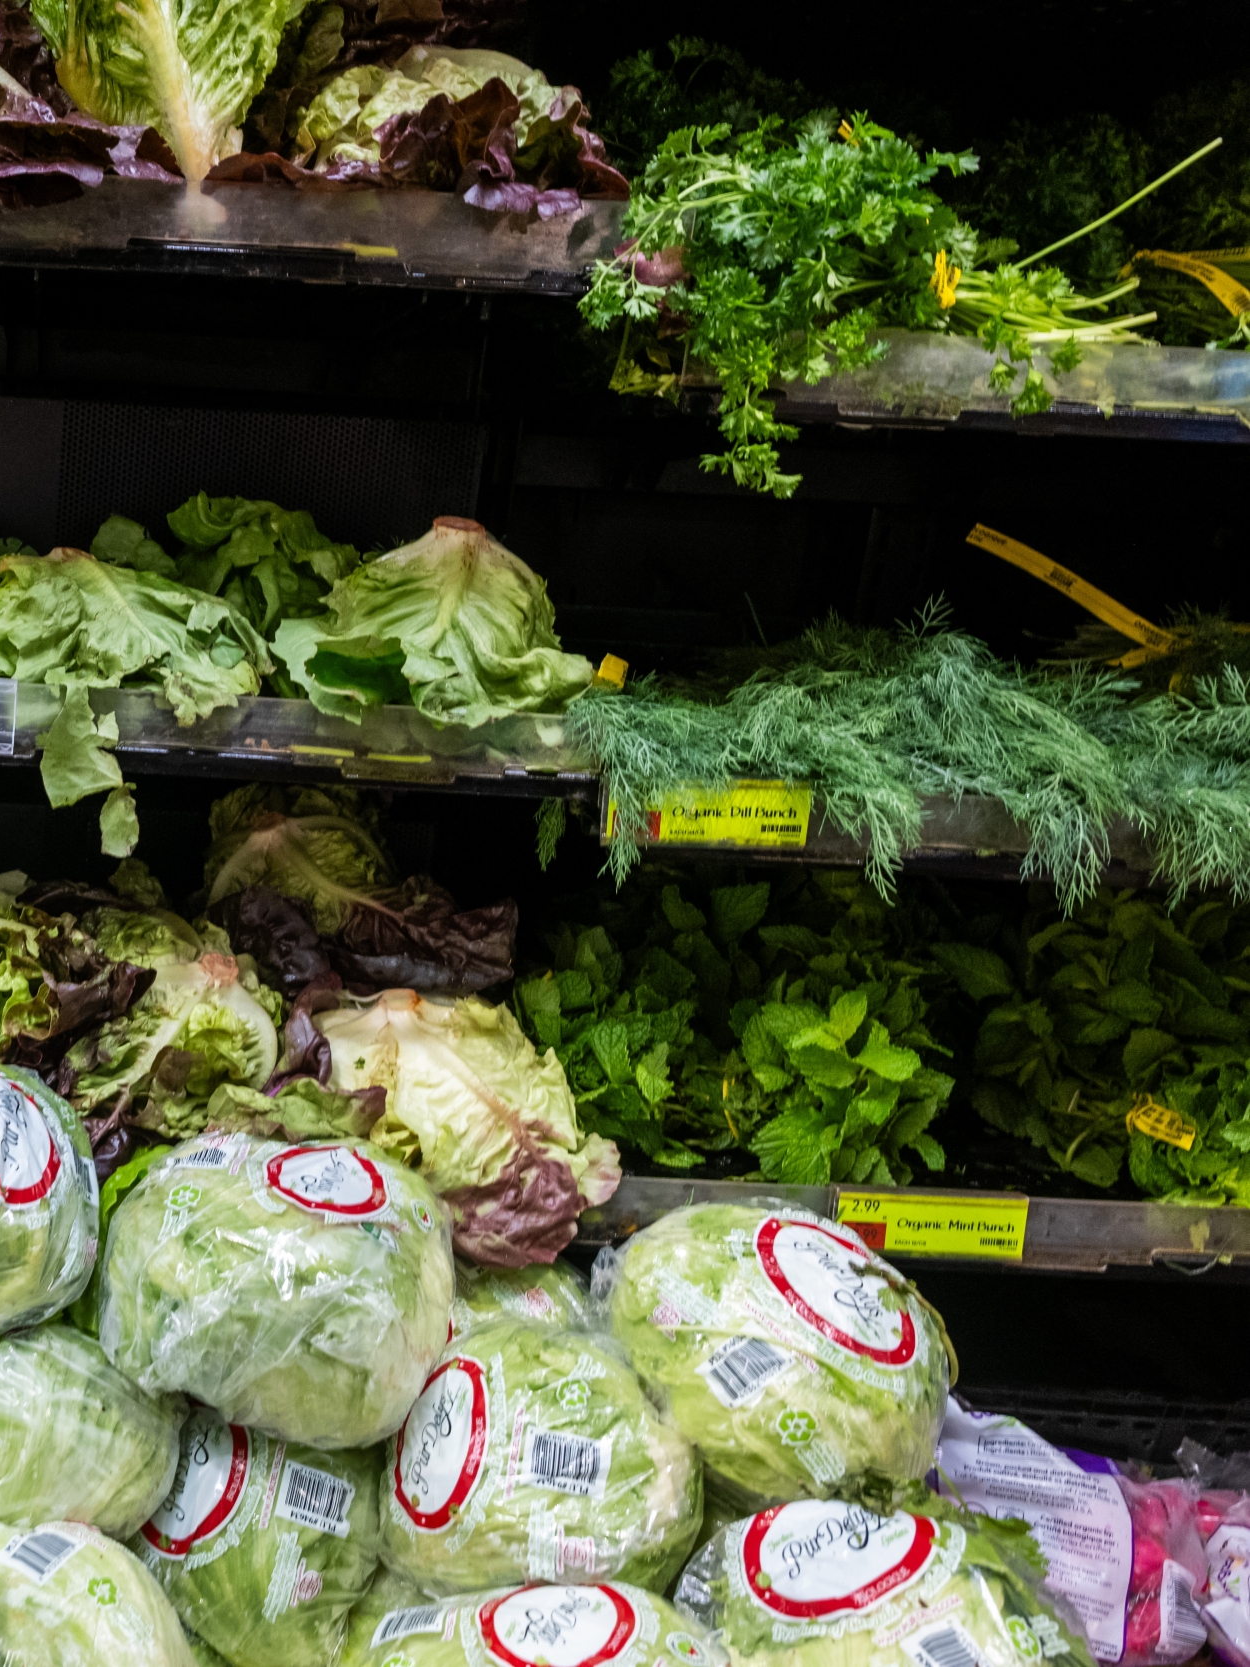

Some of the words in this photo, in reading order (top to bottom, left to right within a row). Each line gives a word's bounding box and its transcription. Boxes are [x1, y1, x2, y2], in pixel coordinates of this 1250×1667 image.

[672, 806, 728, 820] Oganic
[730, 807, 752, 818] Dill
[755, 807, 797, 819] Bunch
[852, 1198, 880, 1213] 2.99
[897, 1217, 946, 1232] Organic
[949, 1219, 974, 1232] Mint
[977, 1221, 1015, 1234] Bunch
